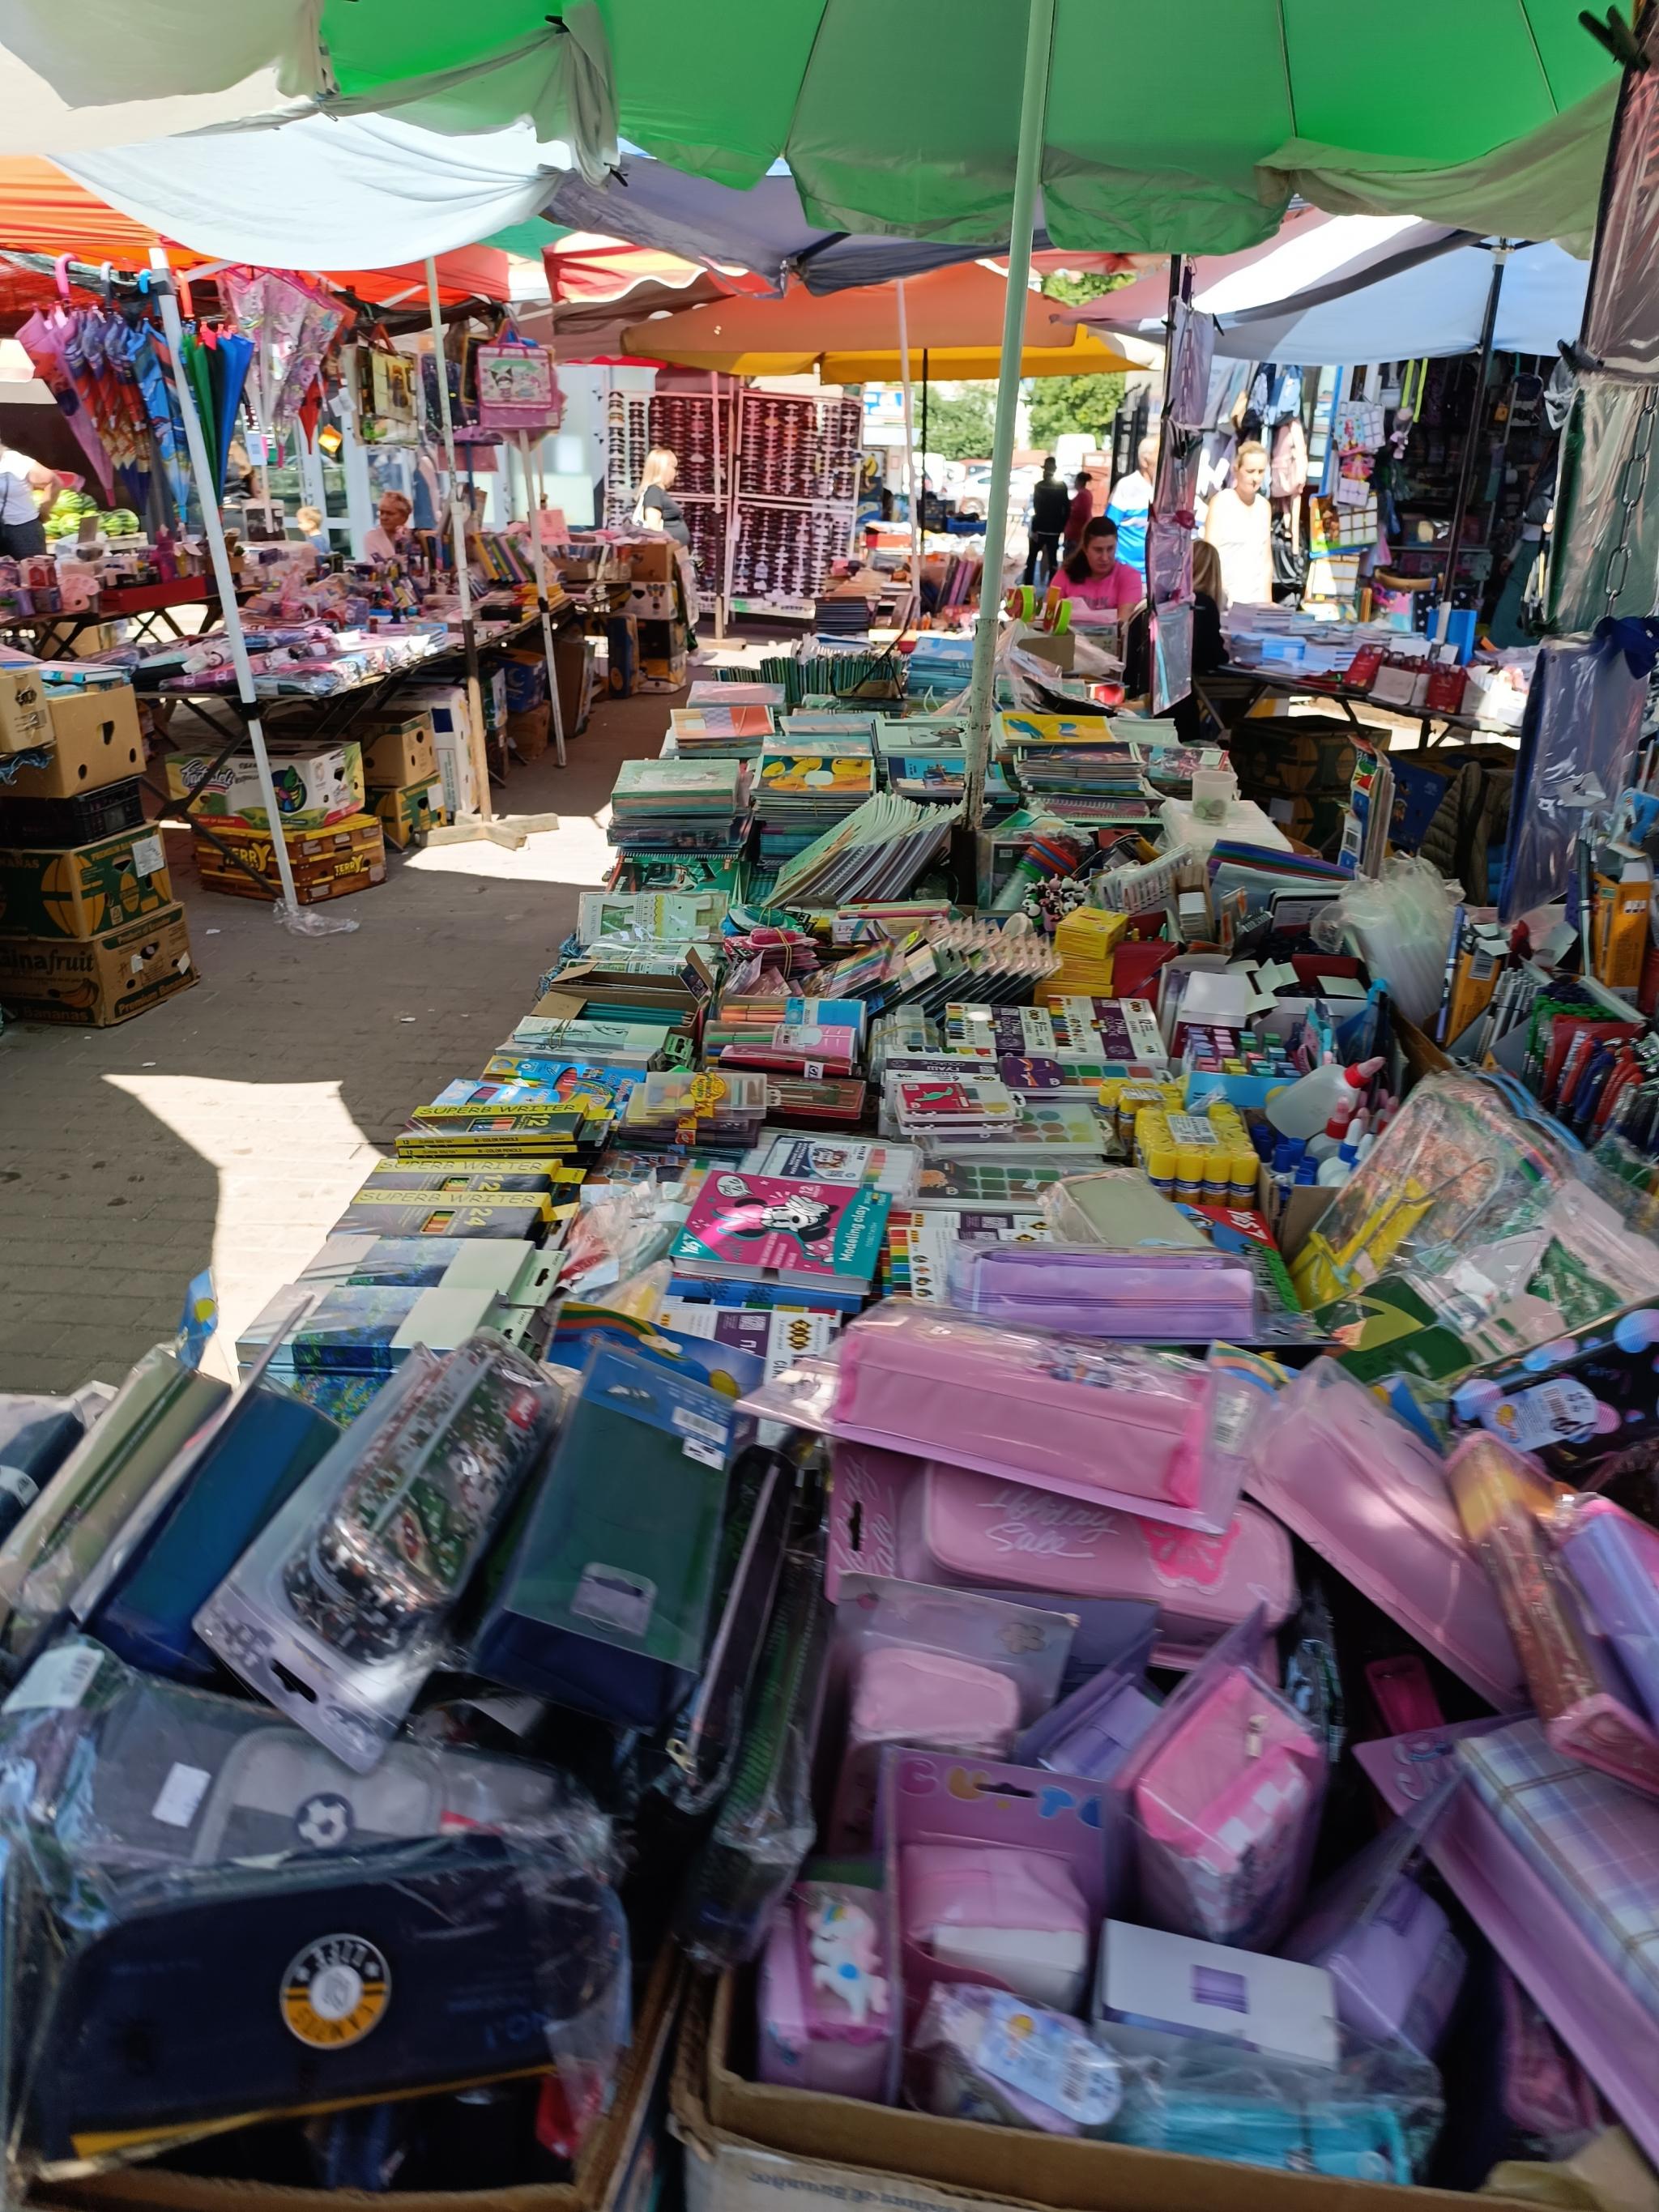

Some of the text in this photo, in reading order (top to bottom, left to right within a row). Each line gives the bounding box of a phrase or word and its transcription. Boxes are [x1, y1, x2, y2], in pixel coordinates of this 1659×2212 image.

[420, 1104, 576, 1115] SUPERB WRITER
[527, 1114, 551, 1127] 12
[379, 1161, 542, 1170] SUPERB WRITER
[478, 1174, 505, 1191] 12
[360, 1192, 535, 1203] SUPERB WRITER
[464, 1207, 493, 1226] 24
[839, 1204, 871, 1262] Modeling clay
[975, 1489, 1121, 1544] Holiday
[985, 1523, 1095, 1559] Sale
